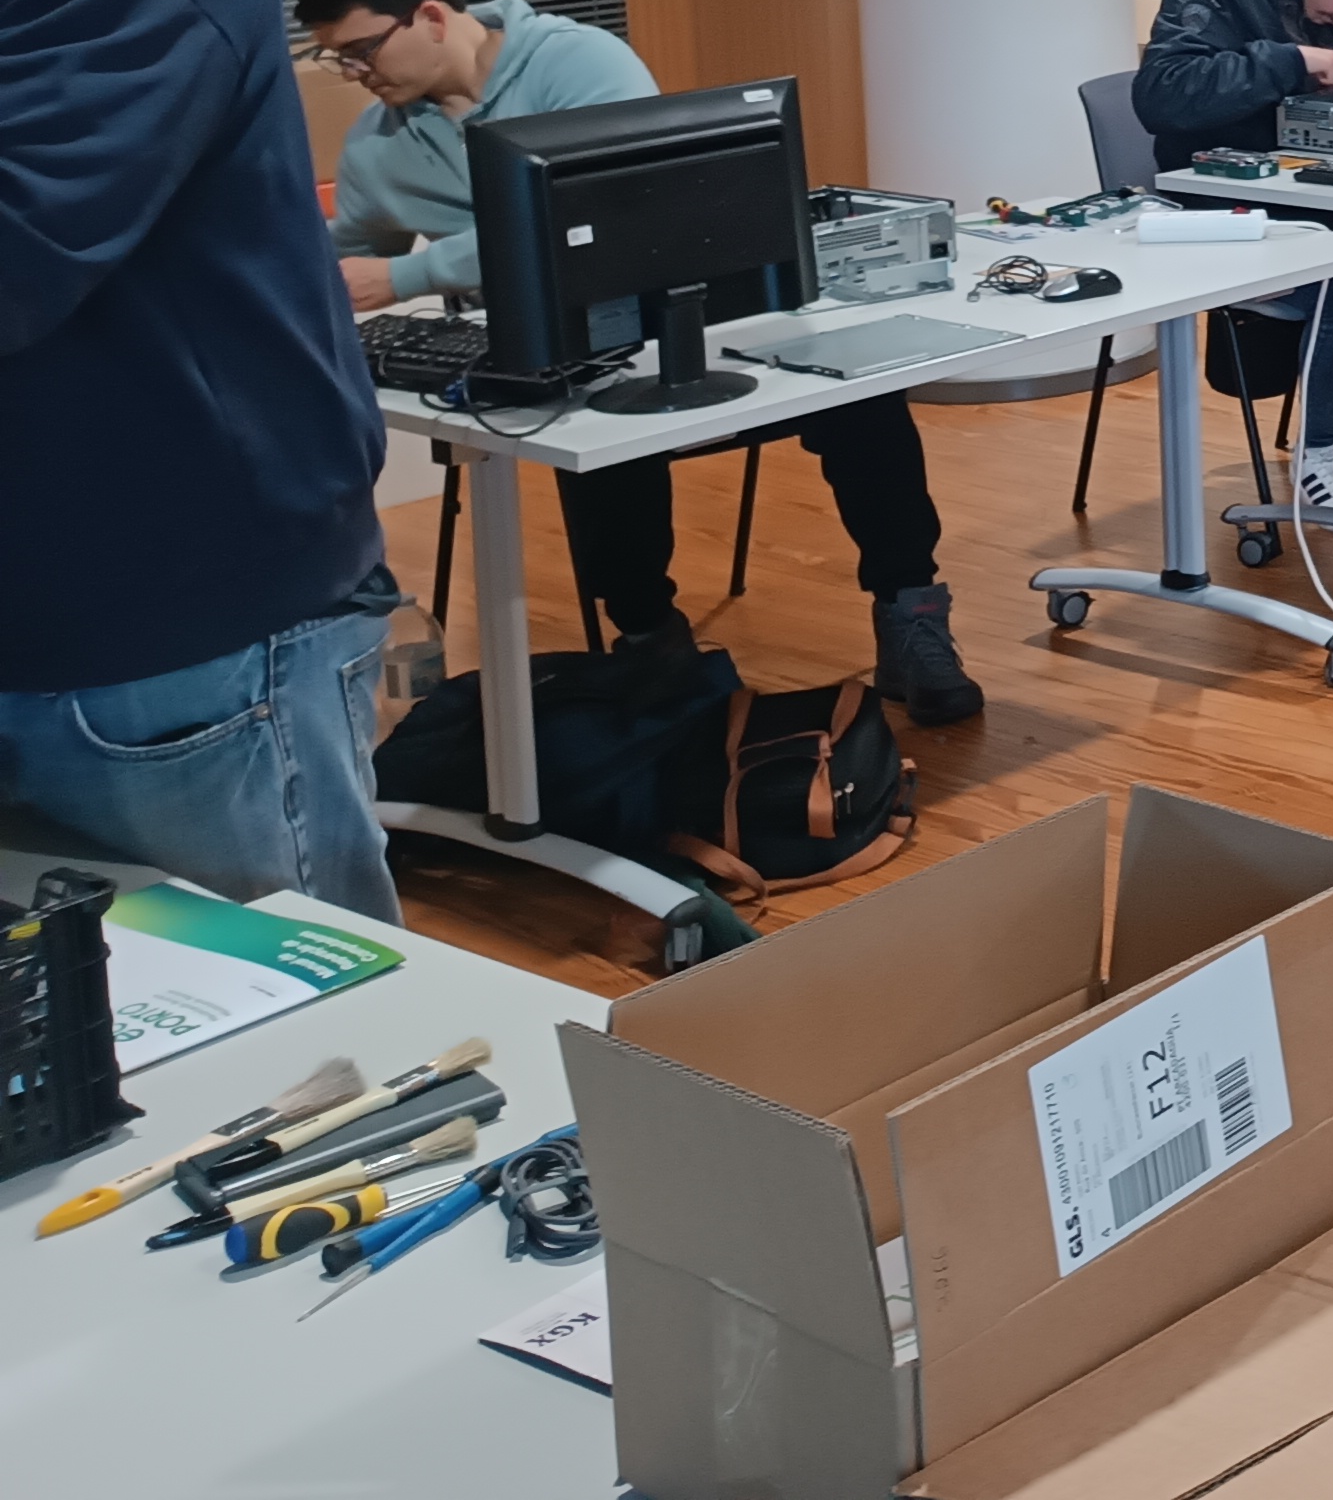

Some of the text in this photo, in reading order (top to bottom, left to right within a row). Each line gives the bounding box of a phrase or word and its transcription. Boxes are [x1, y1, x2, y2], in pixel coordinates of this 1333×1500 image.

[113, 1022, 145, 1043] ec
[117, 1002, 202, 1037] PORTO
[1142, 1041, 1174, 1120] F12
